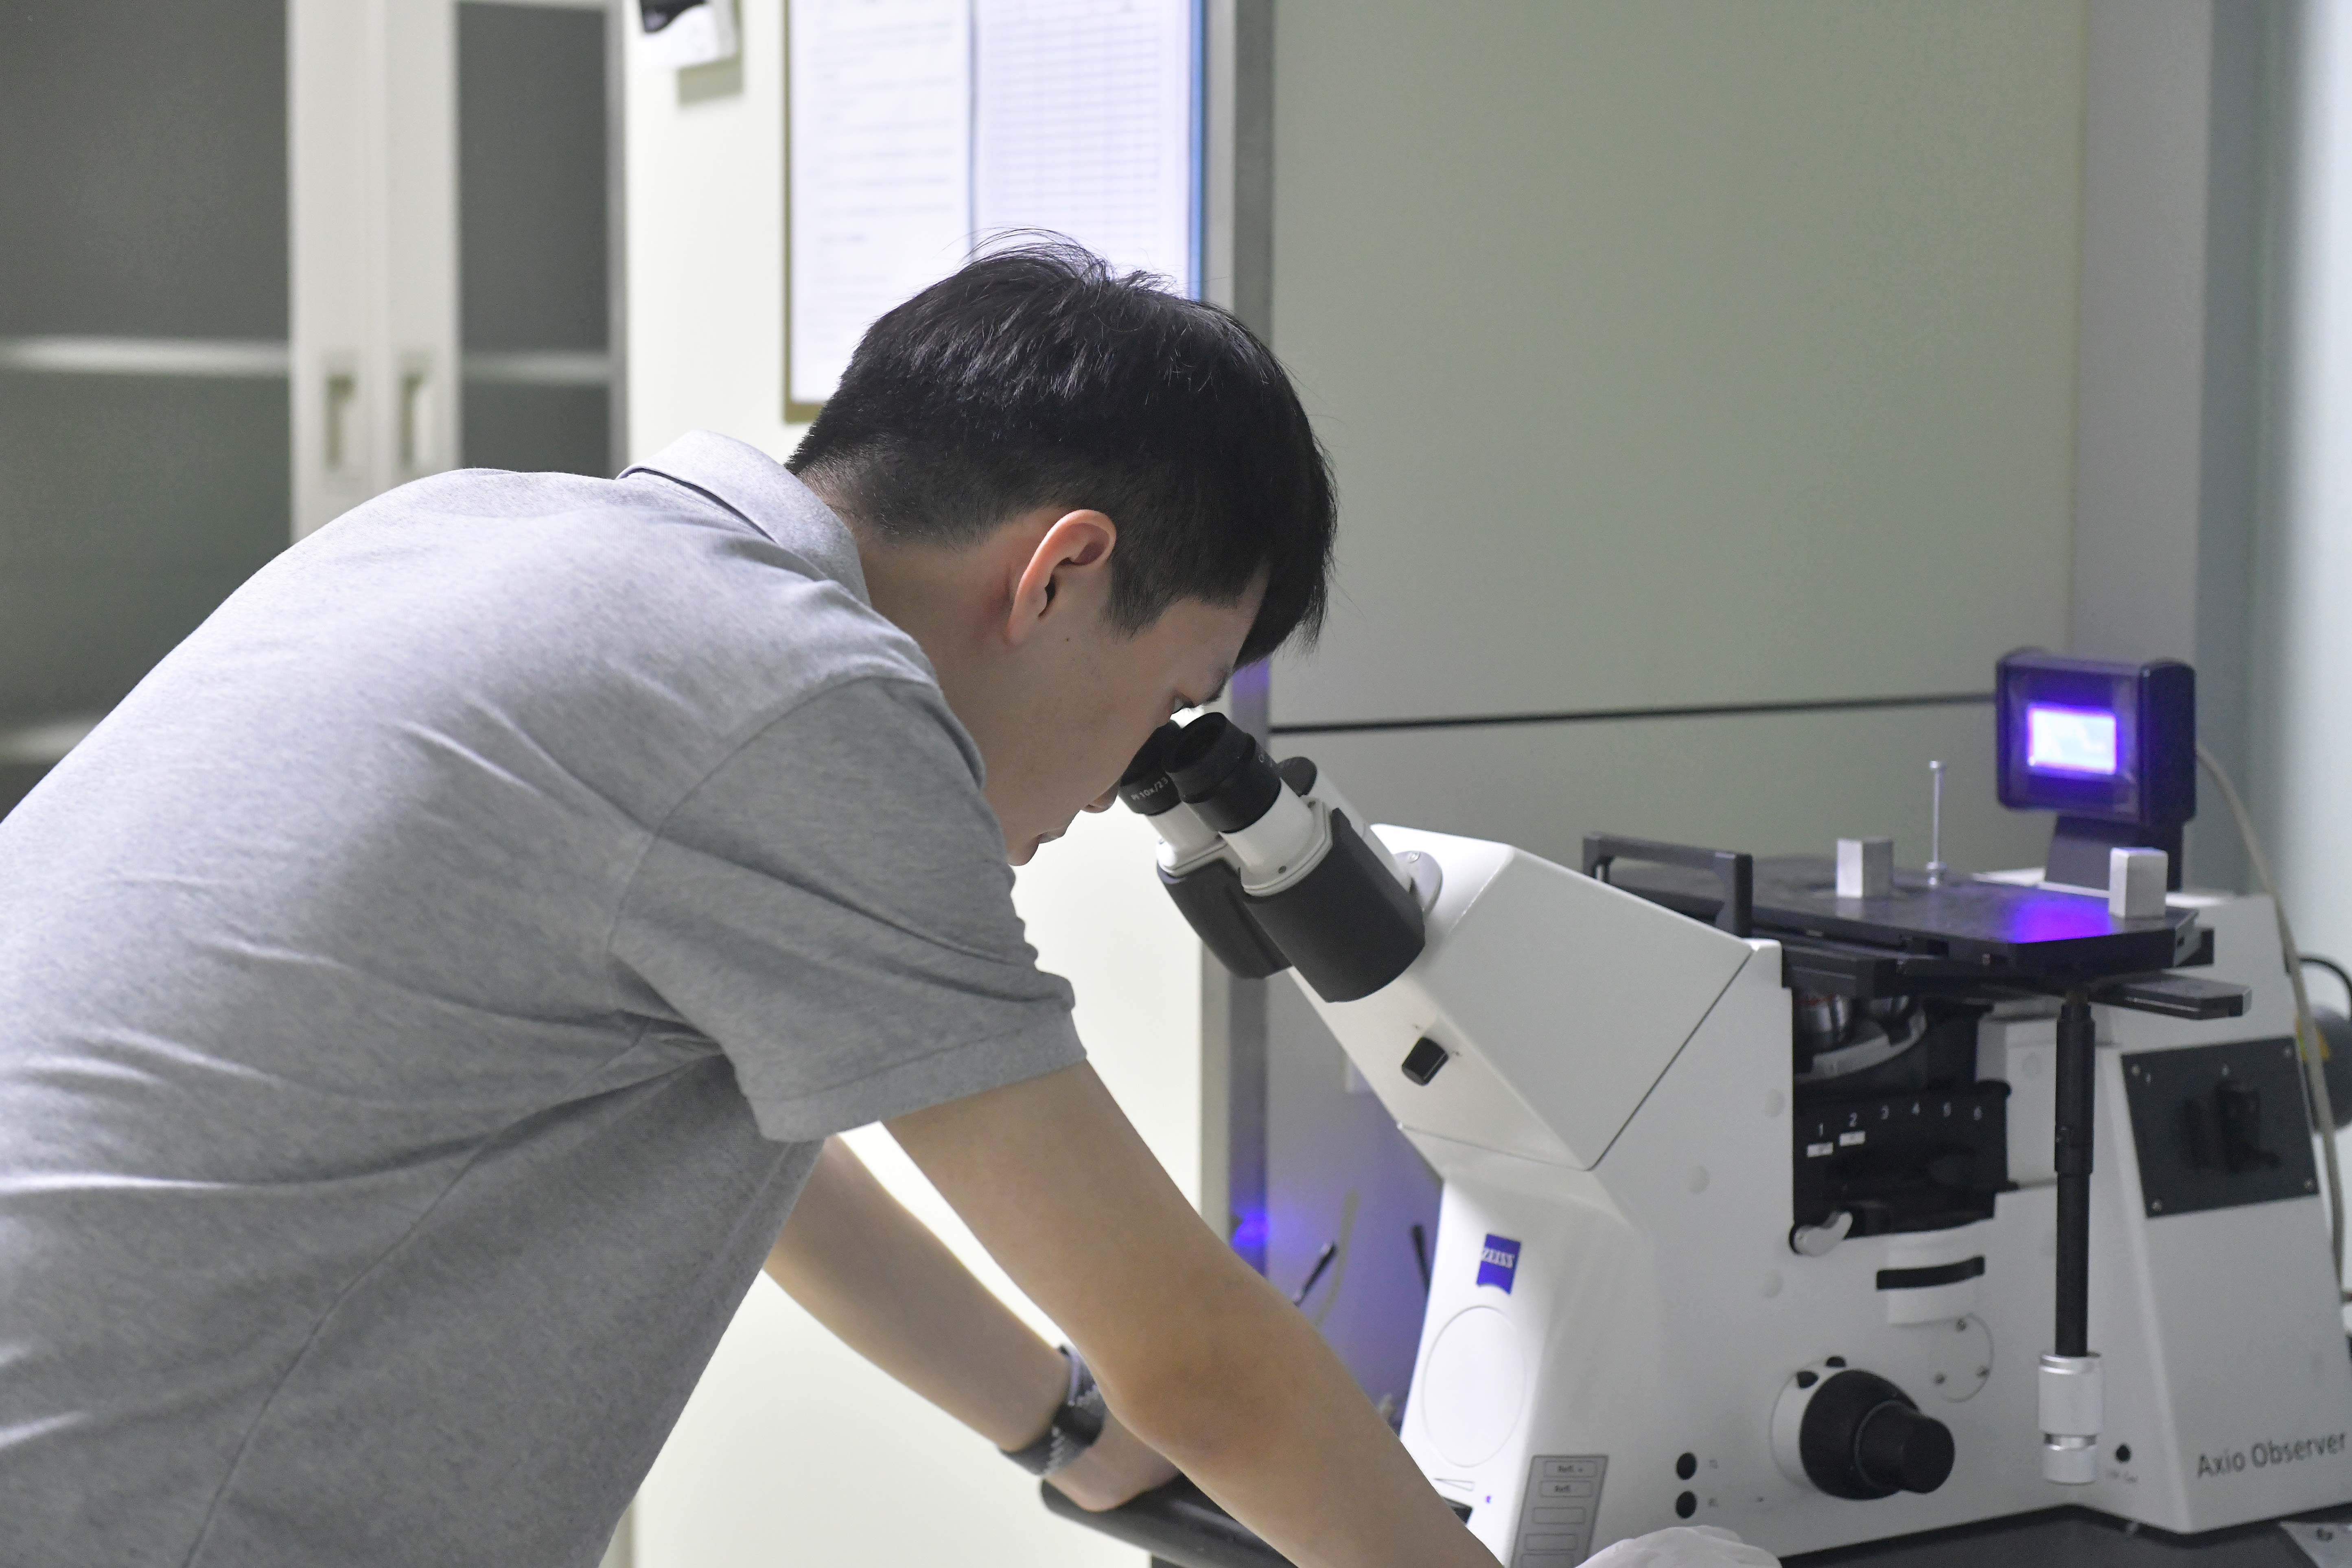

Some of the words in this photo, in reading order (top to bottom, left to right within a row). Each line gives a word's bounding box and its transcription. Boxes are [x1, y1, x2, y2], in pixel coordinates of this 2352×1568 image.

[1819, 1122, 1824, 1138] 1
[1849, 1112, 1858, 1127] 2
[1880, 1104, 1889, 1120] 3
[1481, 1247, 1515, 1269] ZEISS
[2196, 1447, 2246, 1479] Axio
[2251, 1432, 2345, 1468] Observer
